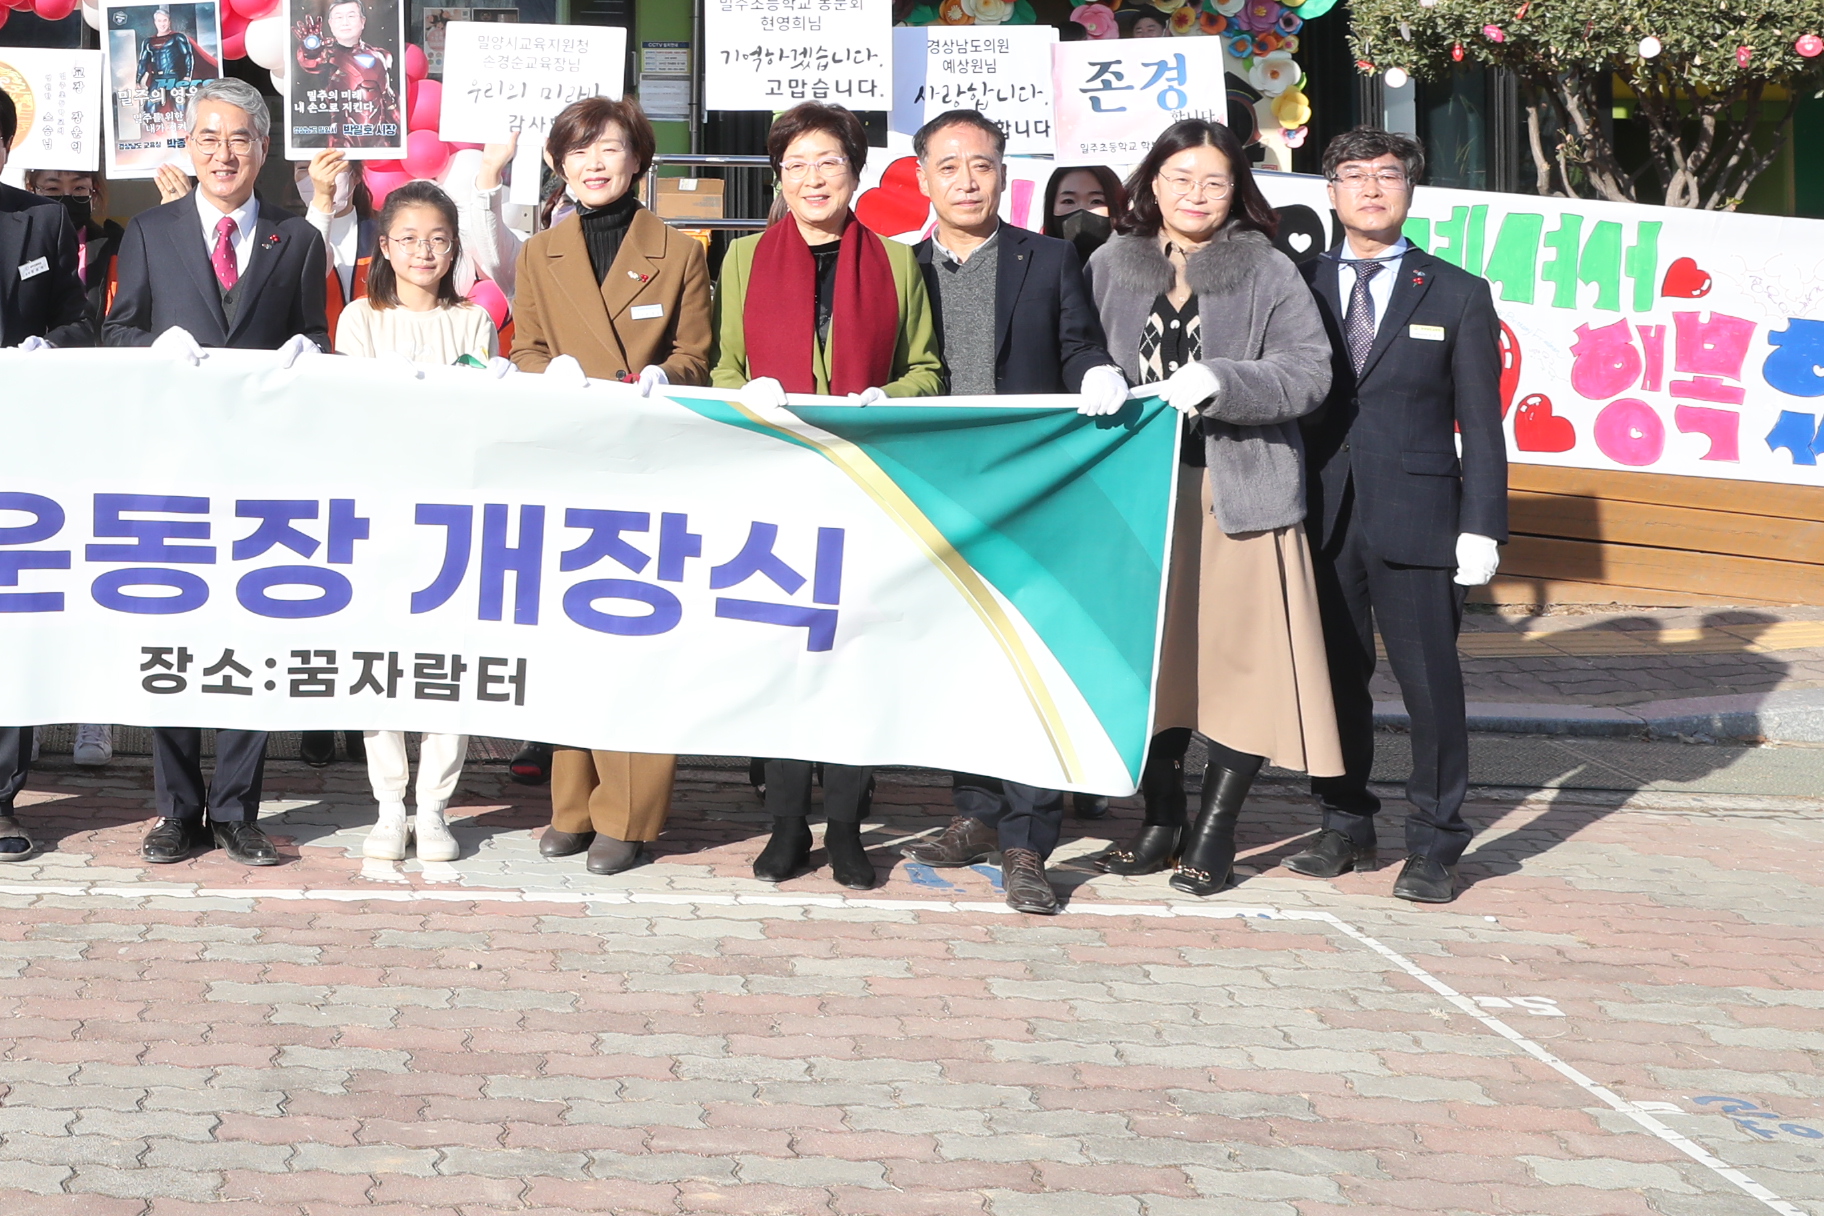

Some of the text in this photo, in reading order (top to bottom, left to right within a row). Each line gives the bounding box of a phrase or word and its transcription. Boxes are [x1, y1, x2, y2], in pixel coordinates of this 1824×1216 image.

[760, 15, 821, 31] 현영희님
[478, 35, 589, 54] 밀양시교육지원청
[927, 38, 1010, 55] 경상남도의원
[483, 55, 581, 72] 손경순교육장님
[720, 45, 883, 73] 기억하겠습니다.
[942, 58, 997, 74] 예상원님
[467, 79, 527, 104] 우리의
[765, 78, 884, 99] 고맙습니다.
[1079, 53, 1188, 113] 존경
[118, 87, 166, 106] 밀주의
[306, 89, 363, 102] 밀주의 미래
[294, 101, 305, 114] 내
[307, 102, 339, 114] 손으로
[343, 124, 374, 136] 박일호
[376, 123, 397, 136] 시장
[410, 503, 845, 653] 개장식
[140, 646, 527, 706] 장소:꿈자람터
